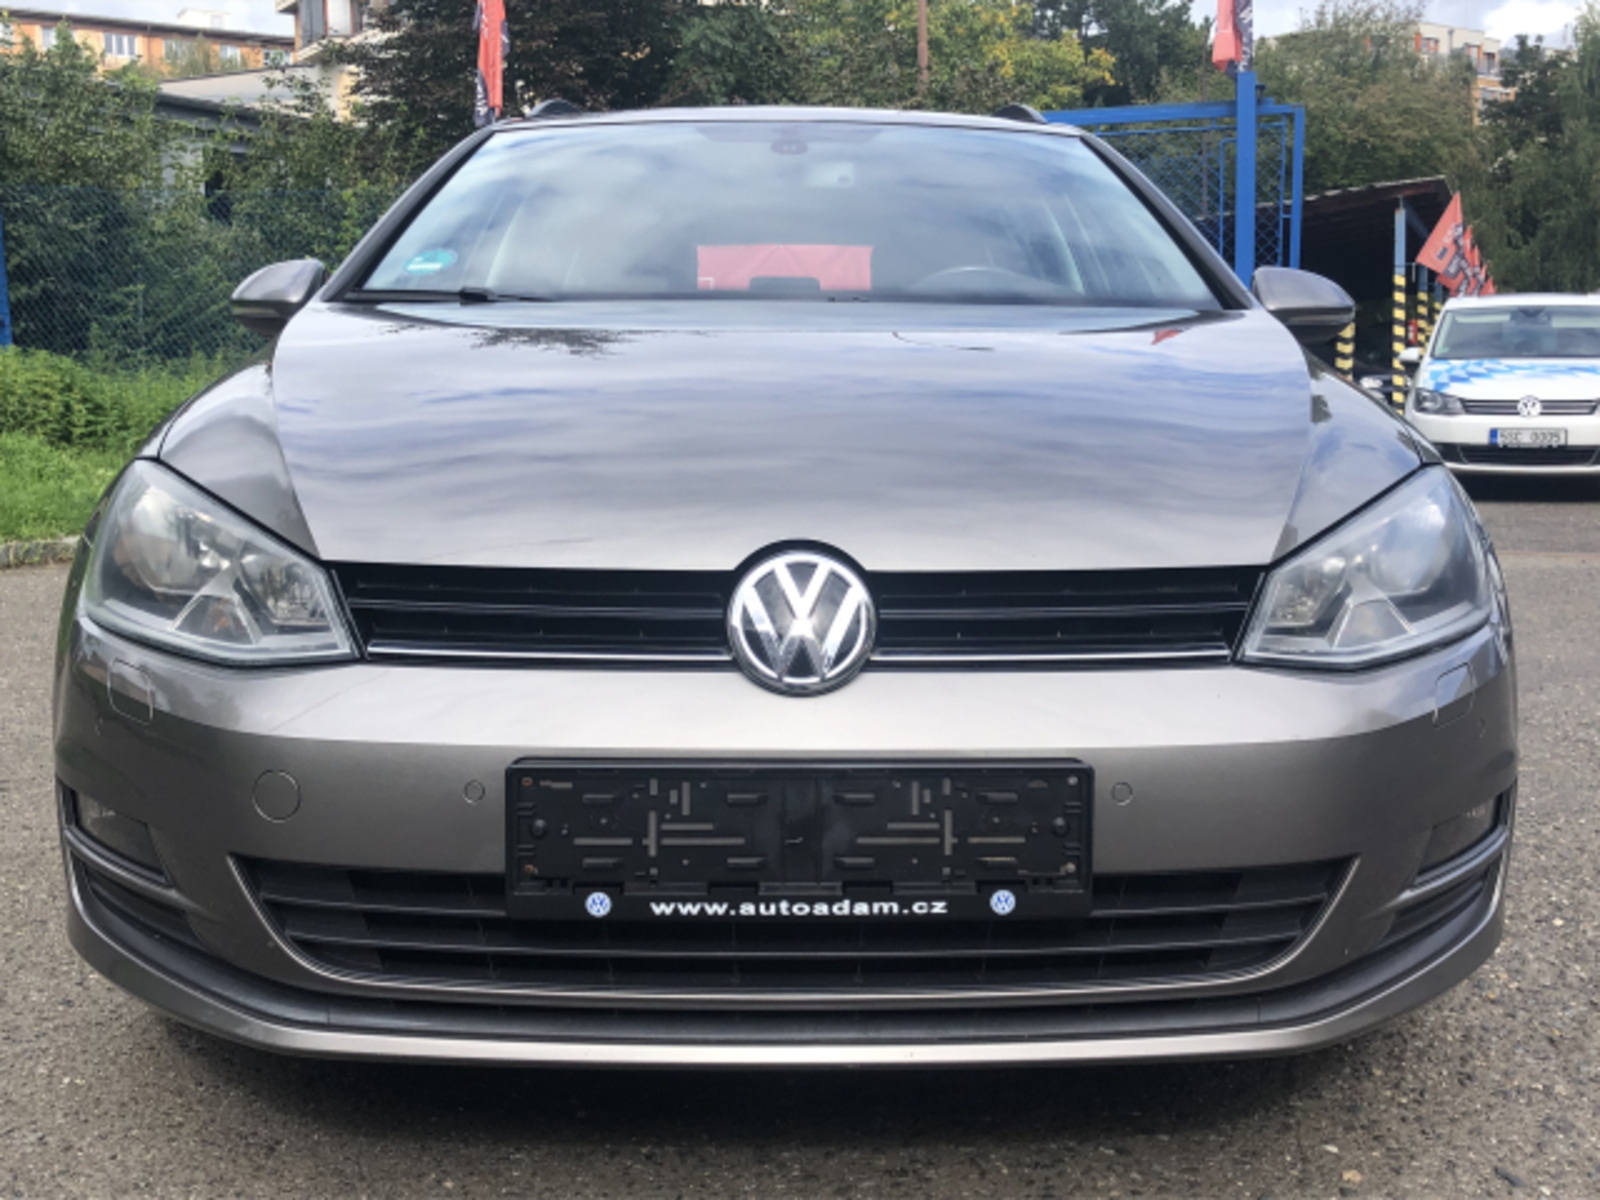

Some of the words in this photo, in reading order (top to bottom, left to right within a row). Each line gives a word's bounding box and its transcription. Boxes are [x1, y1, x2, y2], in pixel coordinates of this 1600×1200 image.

[728, 549, 876, 692] VW
[585, 891, 612, 917] VW
[650, 898, 949, 916] www.autoadam.cz
[990, 889, 1016, 915] VW
